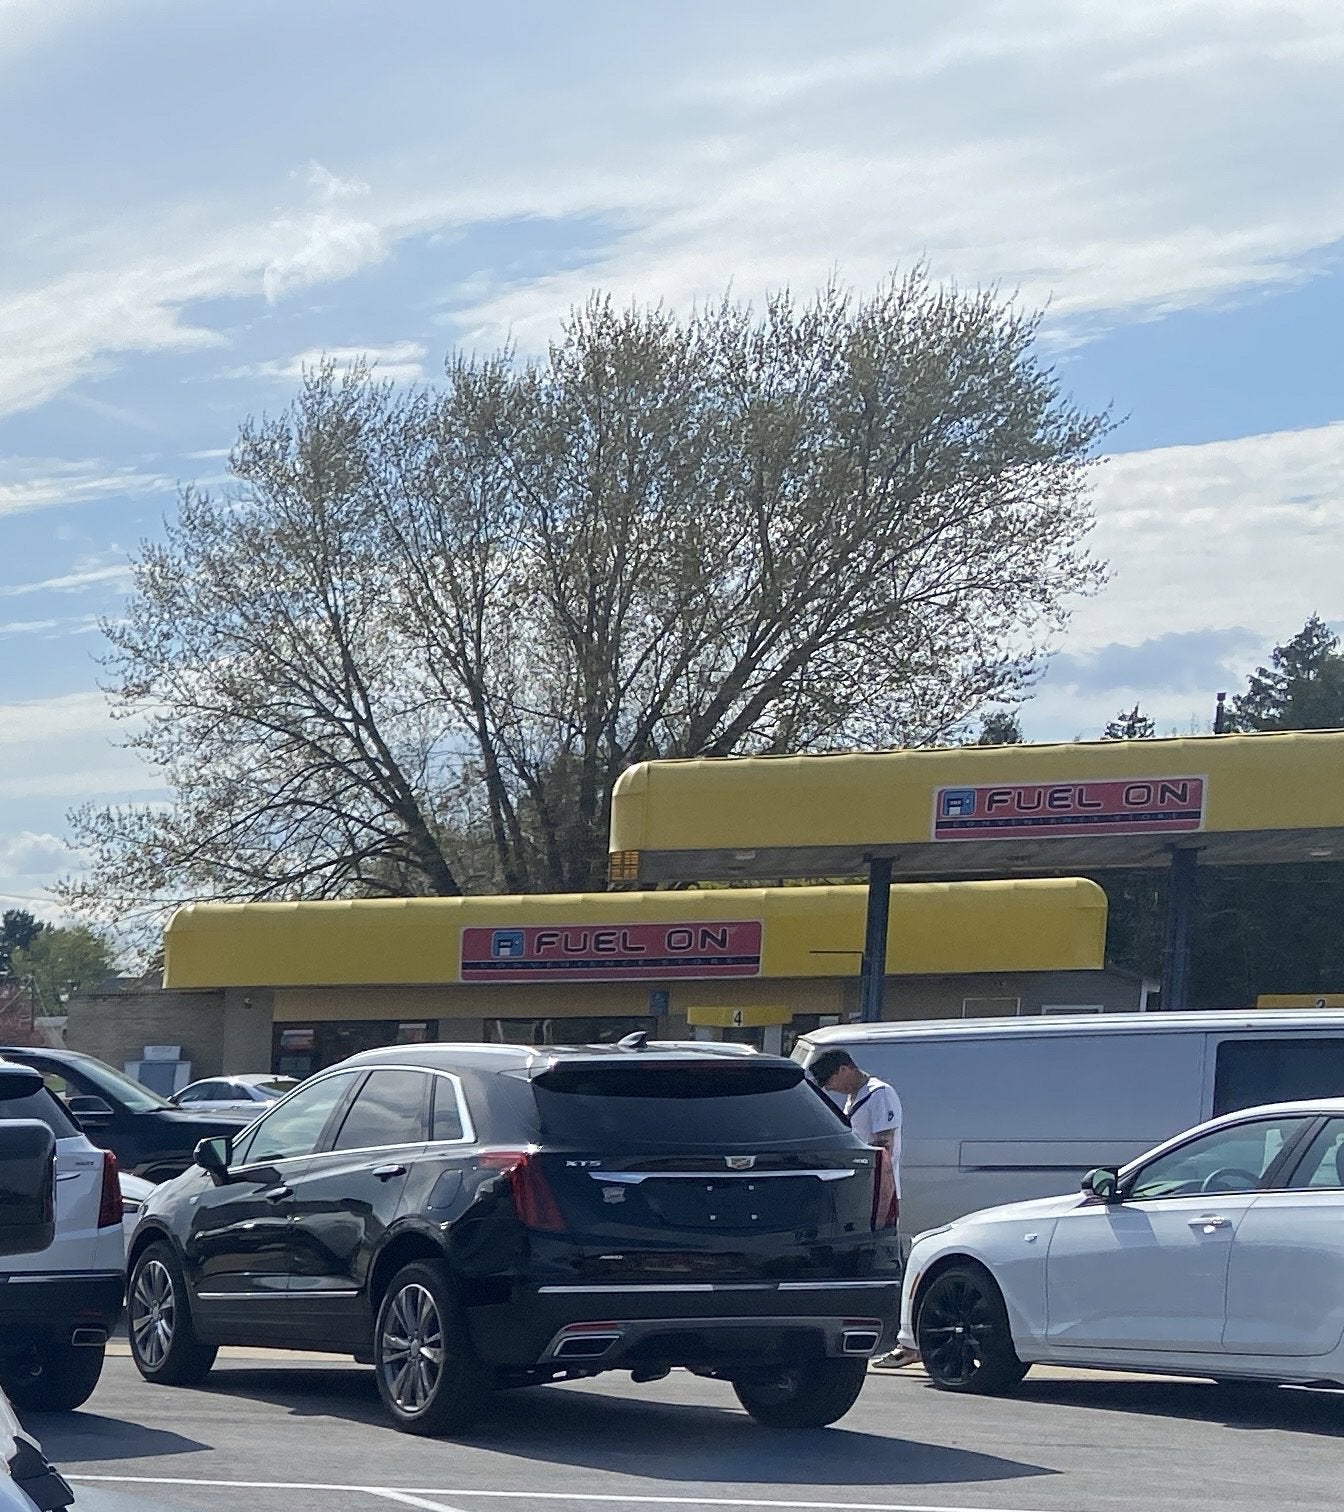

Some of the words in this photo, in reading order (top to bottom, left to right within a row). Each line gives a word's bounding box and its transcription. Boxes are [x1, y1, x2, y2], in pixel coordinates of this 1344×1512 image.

[985, 786, 1104, 813] FUEL
[1123, 781, 1190, 808] ON
[534, 929, 646, 956] FUEL
[666, 927, 730, 952] ON
[733, 1010, 742, 1026] 4
